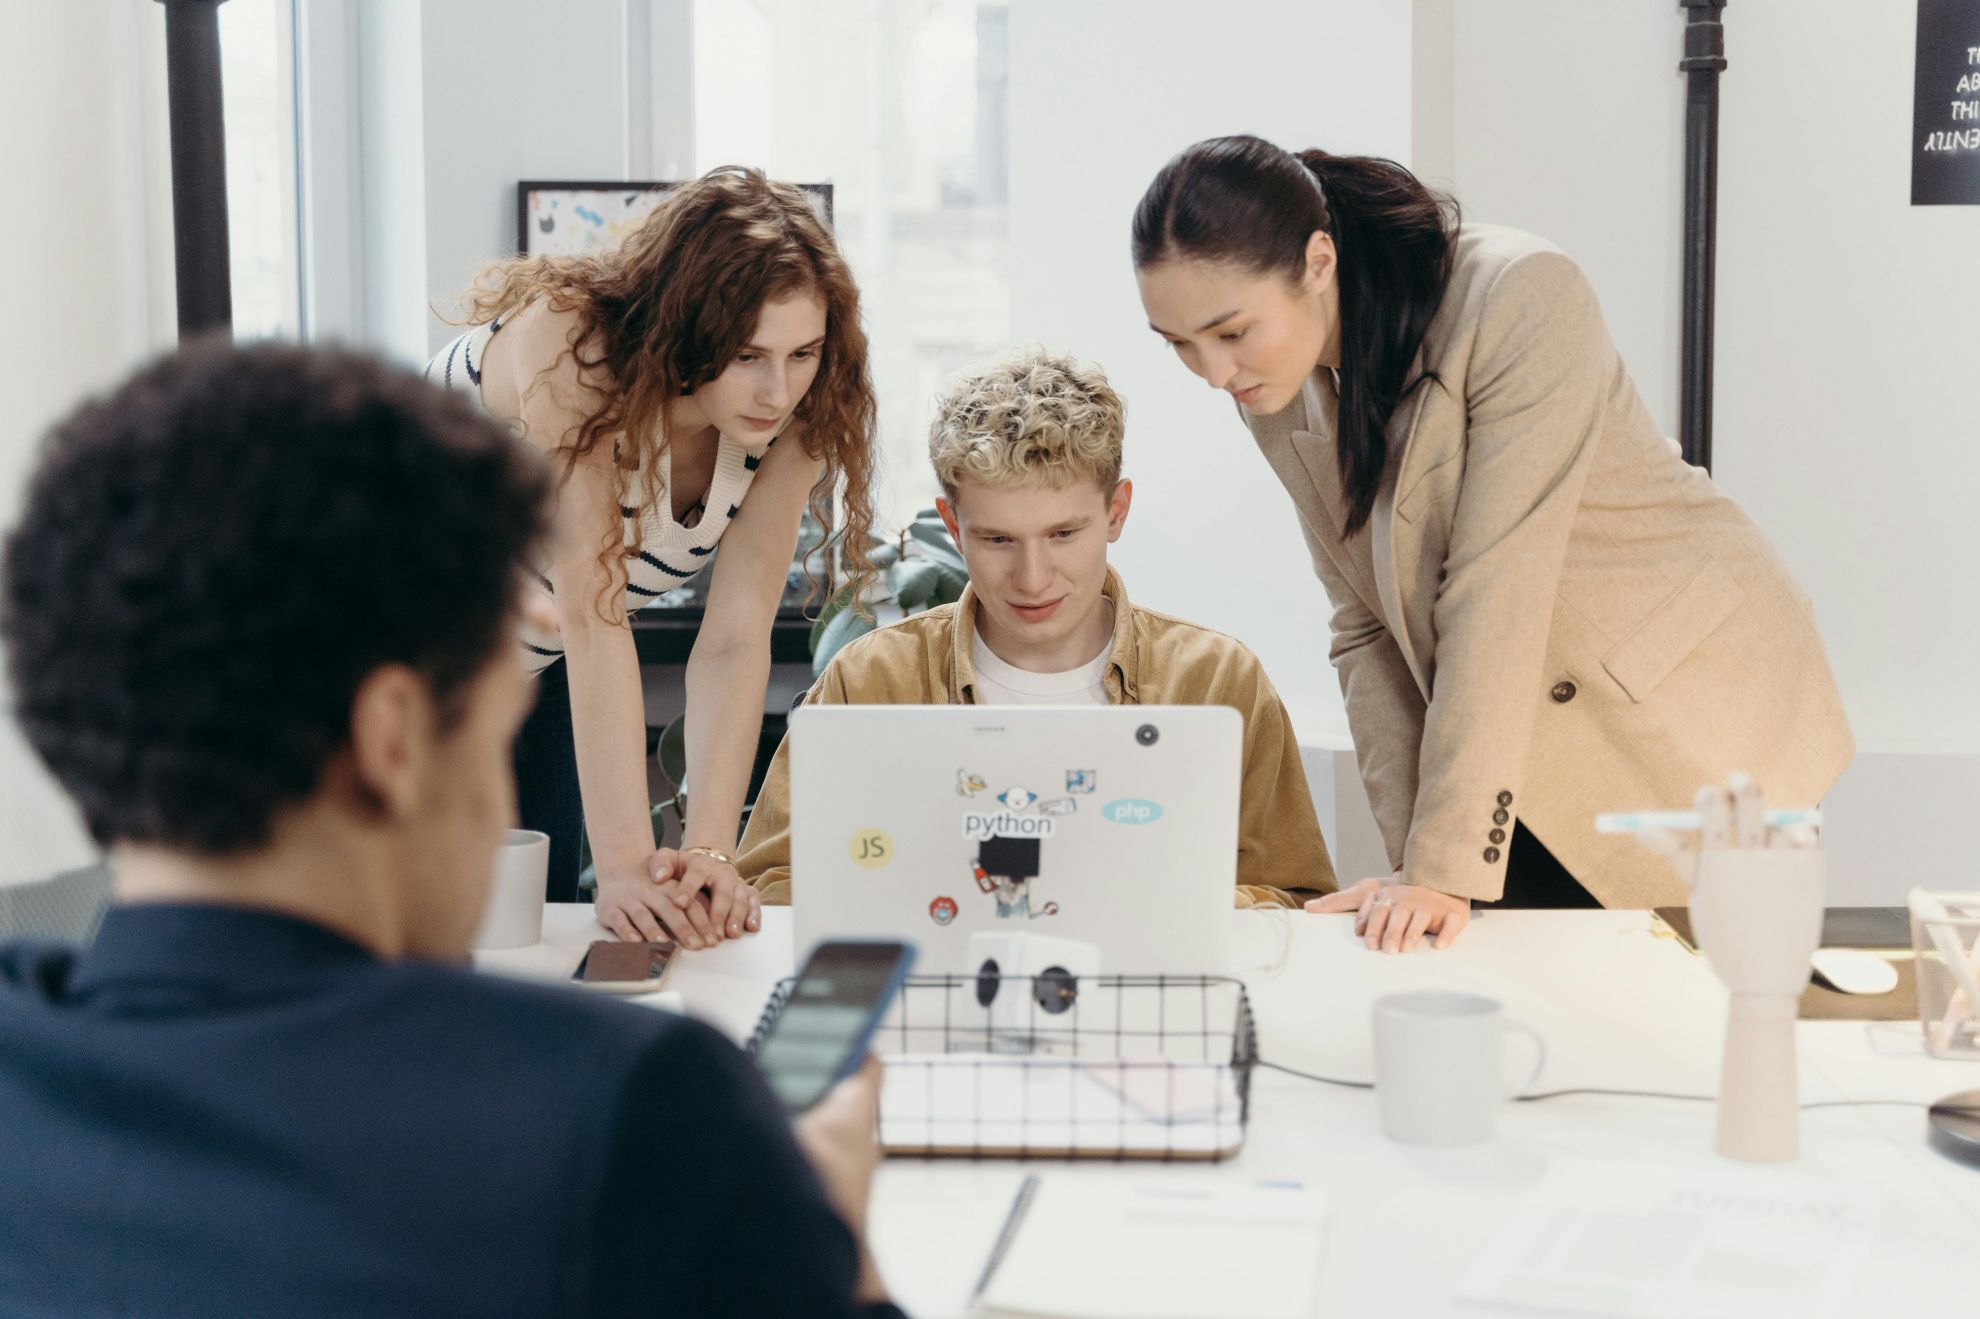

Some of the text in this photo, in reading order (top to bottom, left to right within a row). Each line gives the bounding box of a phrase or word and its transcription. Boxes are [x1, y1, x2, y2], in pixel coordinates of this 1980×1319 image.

[1115, 803, 1152, 819] php
[966, 812, 1052, 836] python
[858, 836, 885, 859] JS
